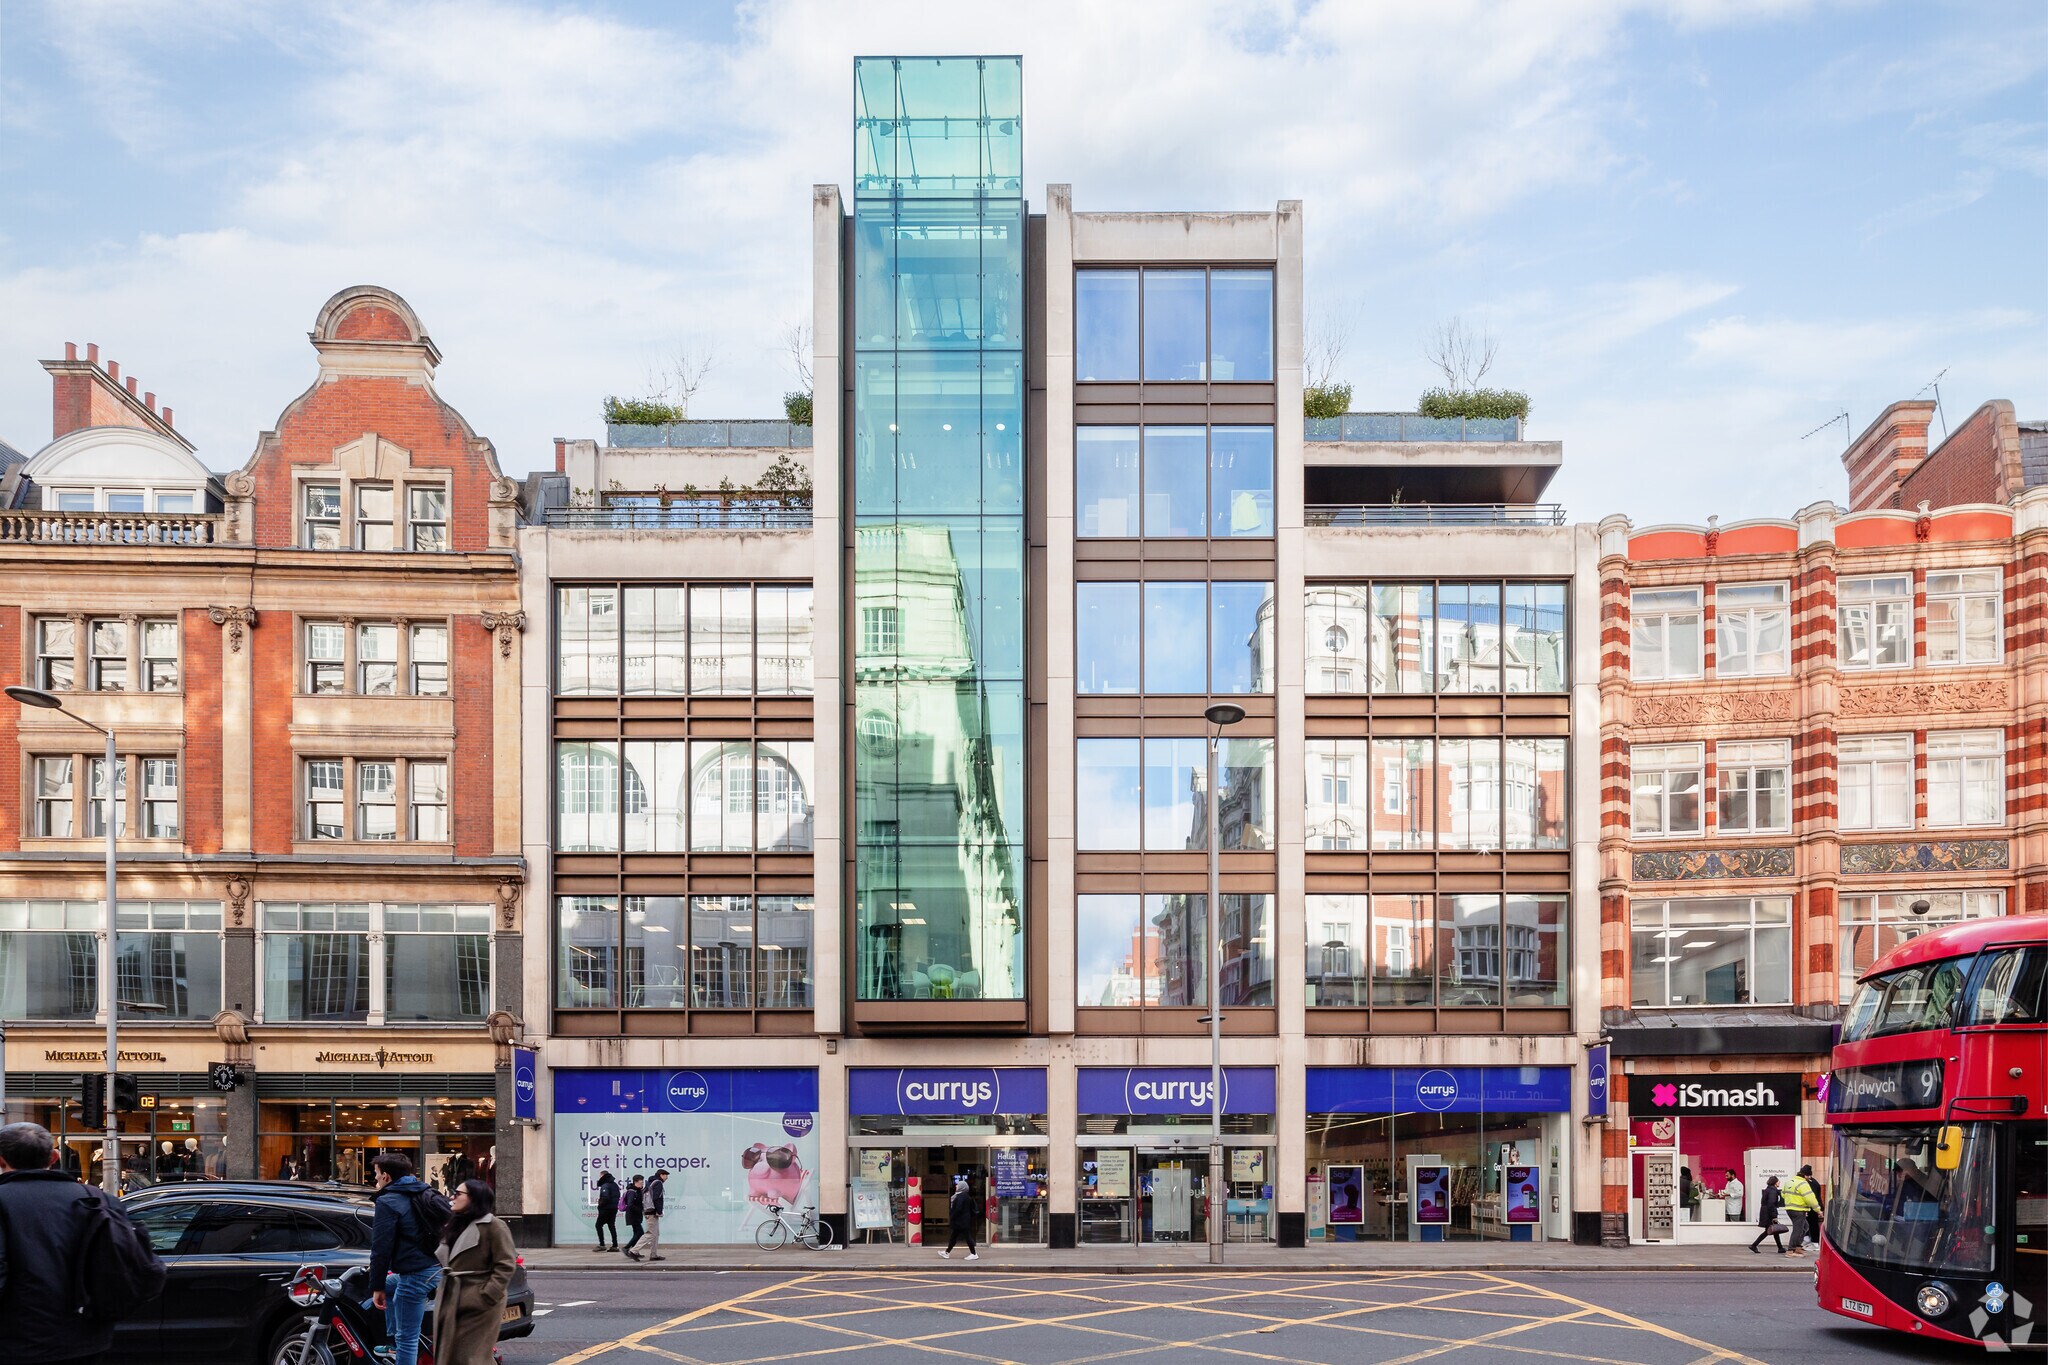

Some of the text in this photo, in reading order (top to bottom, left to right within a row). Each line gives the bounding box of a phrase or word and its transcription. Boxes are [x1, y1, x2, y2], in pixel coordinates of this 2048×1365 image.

[45, 1050, 101, 1061] MICHAEL
[318, 1051, 374, 1063] MICHAEL
[517, 1080, 534, 1091] currys
[1590, 1076, 1606, 1087] currys
[1846, 1070, 1934, 1098] Aldwych 9
[670, 1086, 705, 1098] currys
[905, 1082, 992, 1107] currys
[1134, 1082, 1213, 1107] currys
[1419, 1085, 1456, 1097] currys
[141, 1097, 155, 1107] 02
[372, 1119, 383, 1128] 45
[784, 1118, 813, 1130] currys
[580, 1131, 611, 1147] You
[581, 1153, 711, 1173] get it cheaper.
[1420, 1170, 1438, 1179] Sale.
[1510, 1170, 1528, 1178] Sale.
